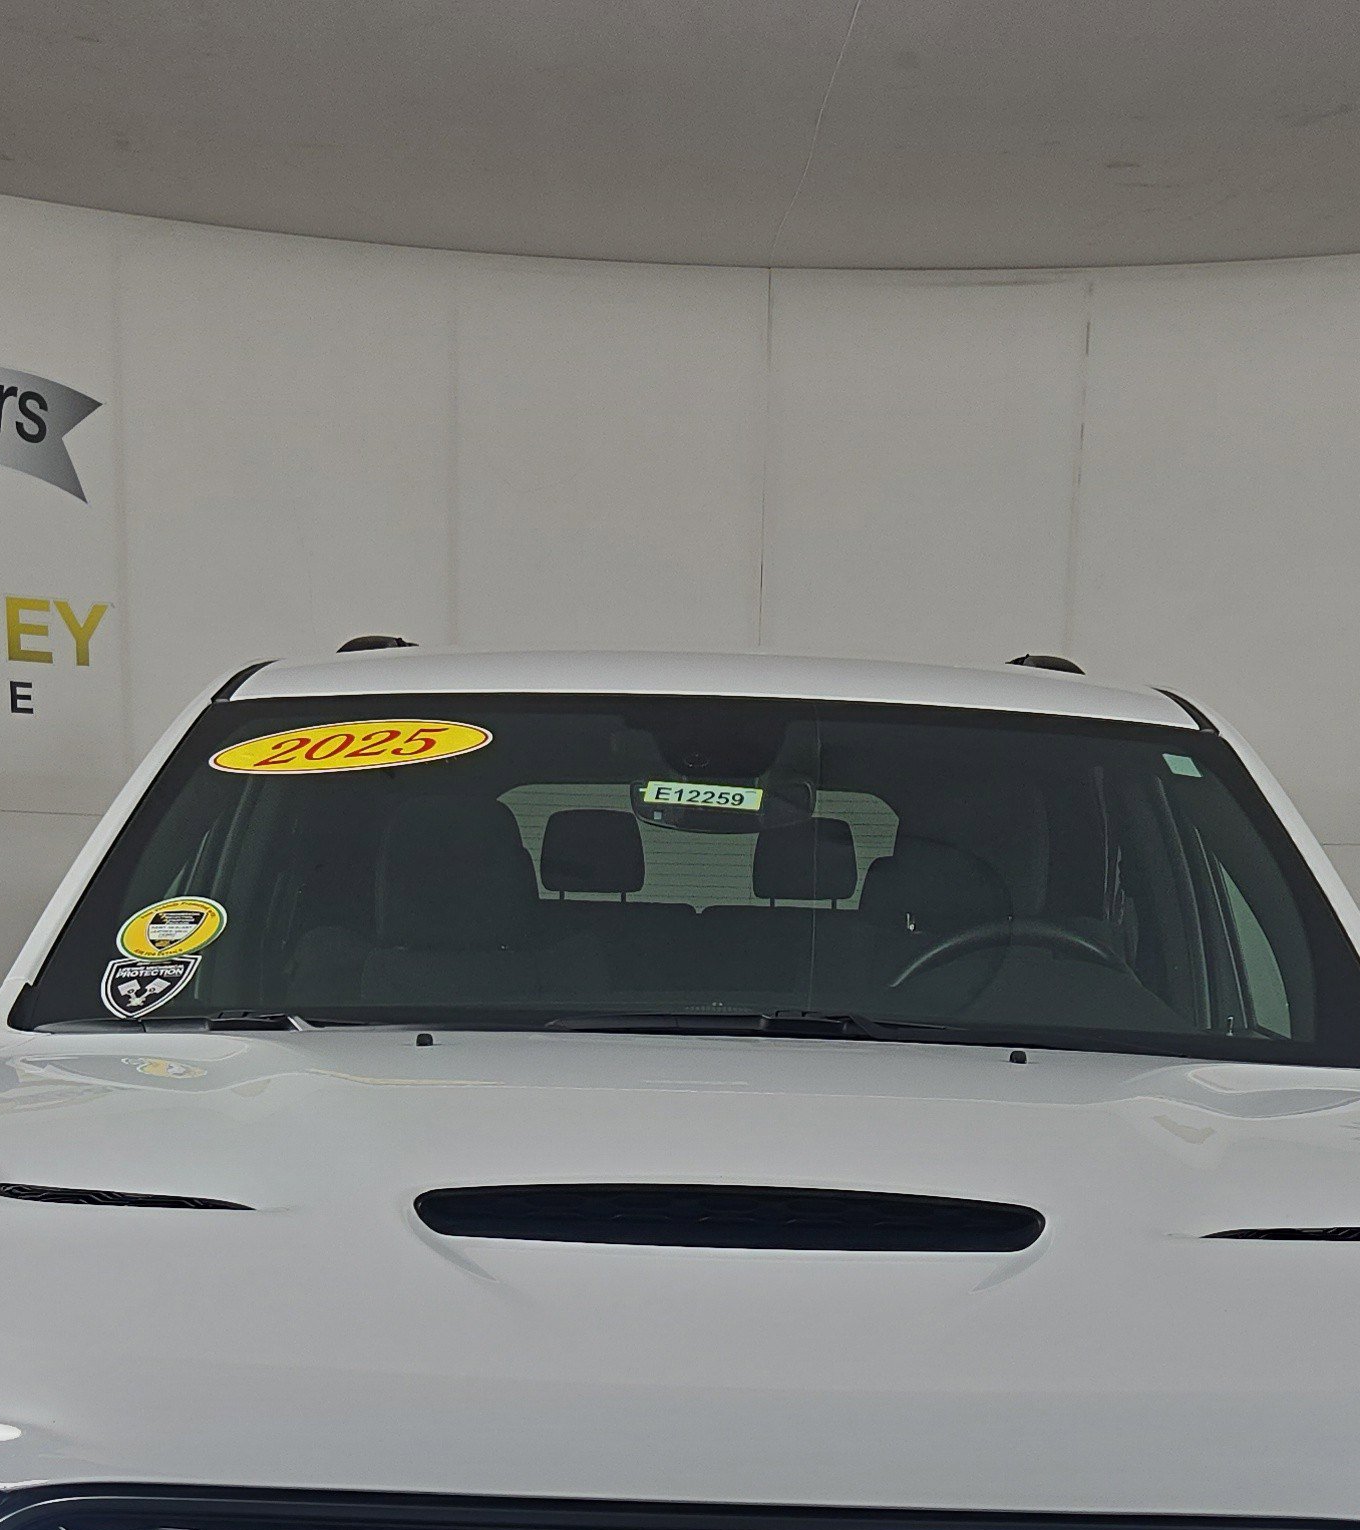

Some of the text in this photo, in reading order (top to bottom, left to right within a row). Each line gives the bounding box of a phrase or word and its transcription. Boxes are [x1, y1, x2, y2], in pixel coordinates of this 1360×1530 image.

[253, 727, 449, 767] 2025
[654, 786, 745, 807] E12259
[115, 966, 185, 979] PROTECTION
